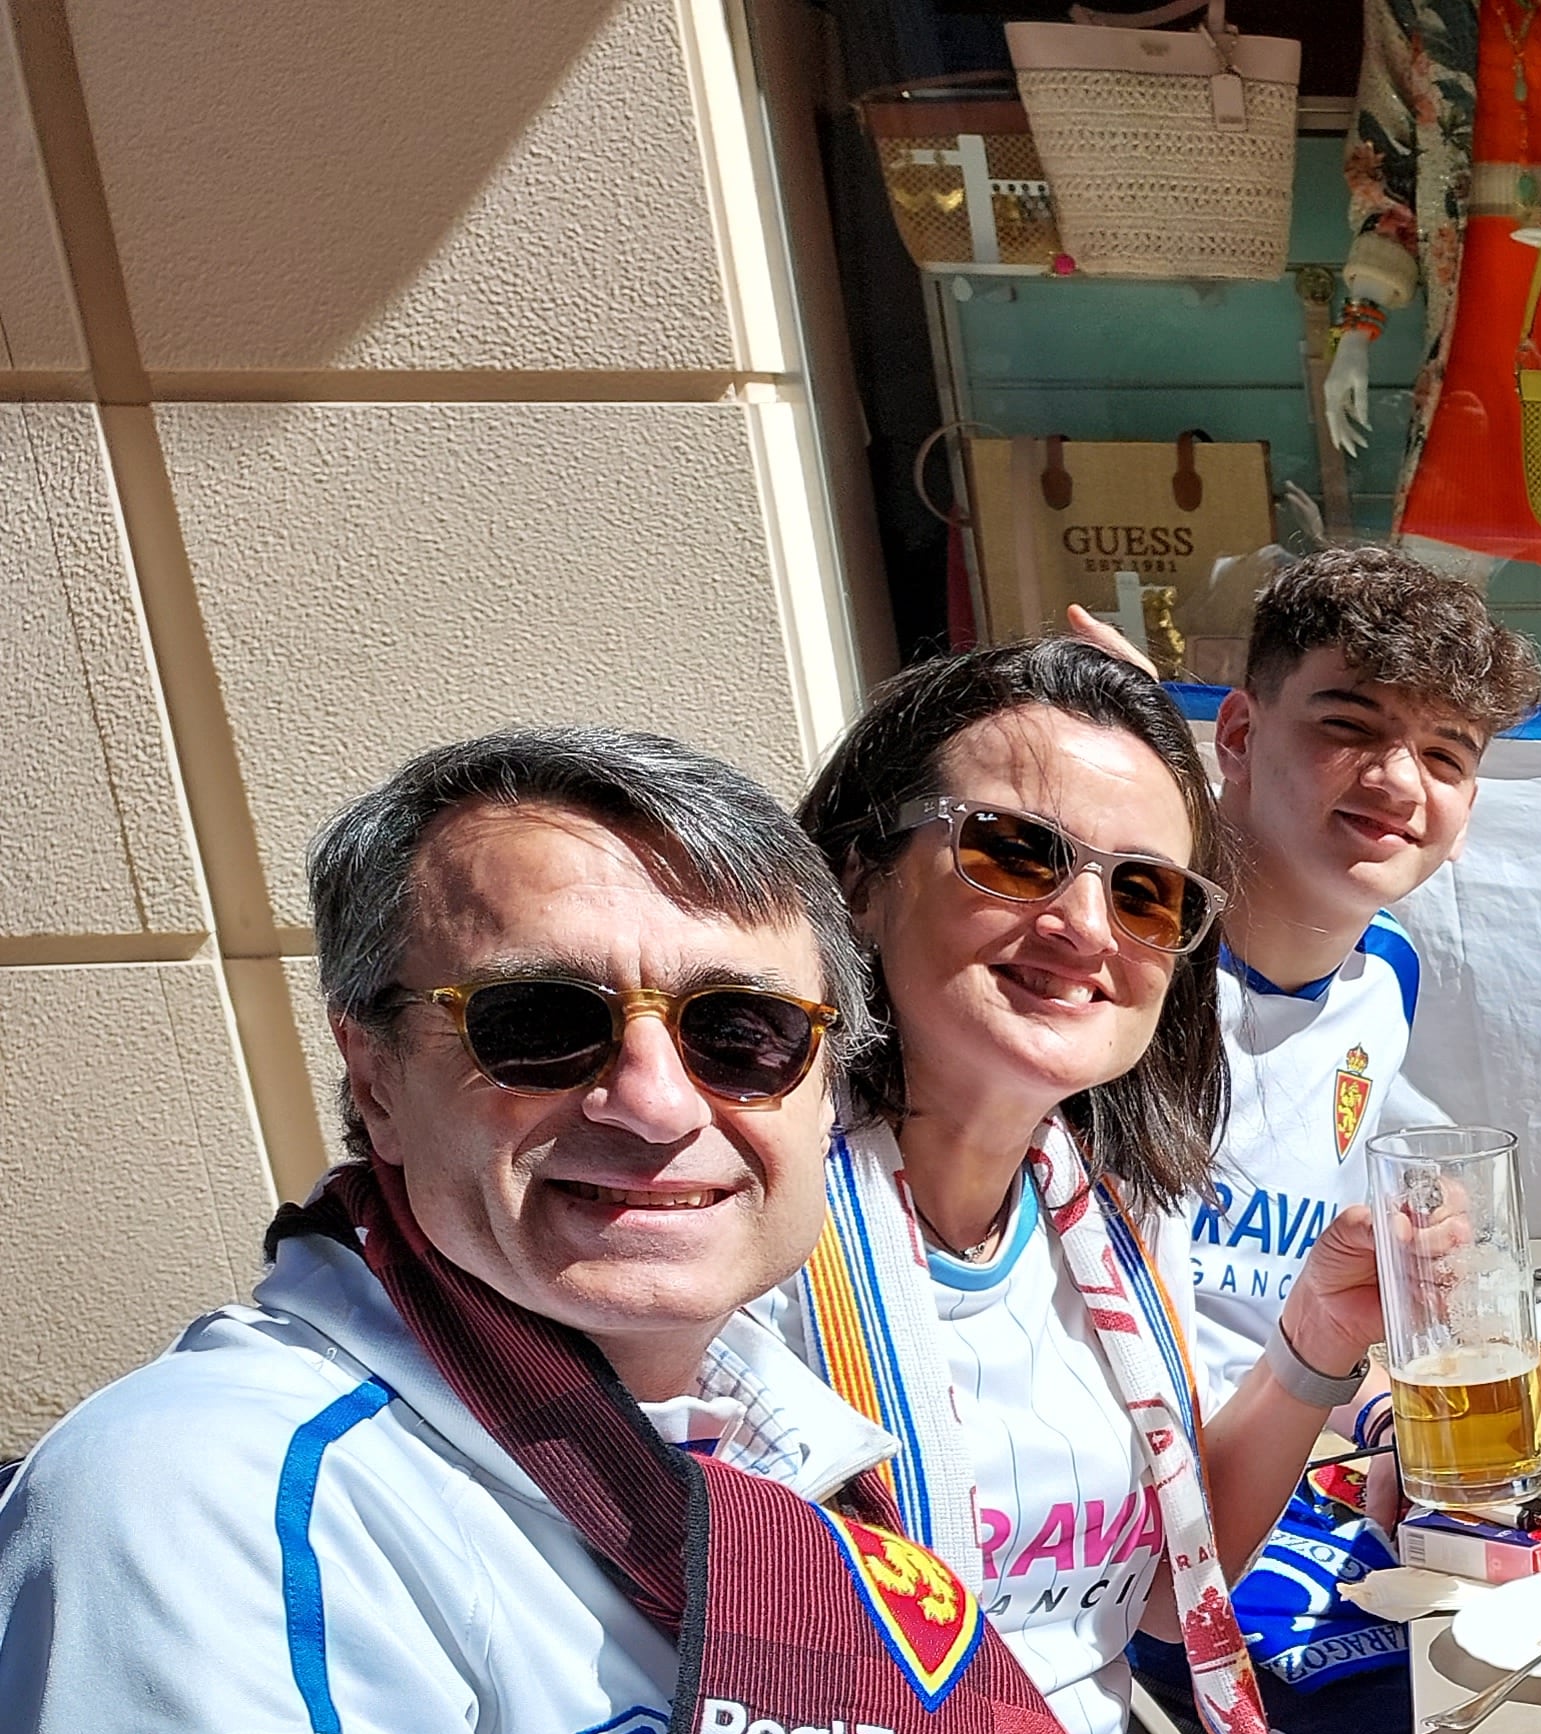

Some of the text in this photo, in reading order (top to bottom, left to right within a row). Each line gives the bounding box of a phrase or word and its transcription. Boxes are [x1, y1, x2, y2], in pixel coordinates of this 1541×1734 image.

[1062, 525, 1195, 557] GUESS
[1131, 559, 1177, 573] 1981
[1191, 1176, 1338, 1260] RAVA
[982, 1484, 1165, 1581] RAVA
